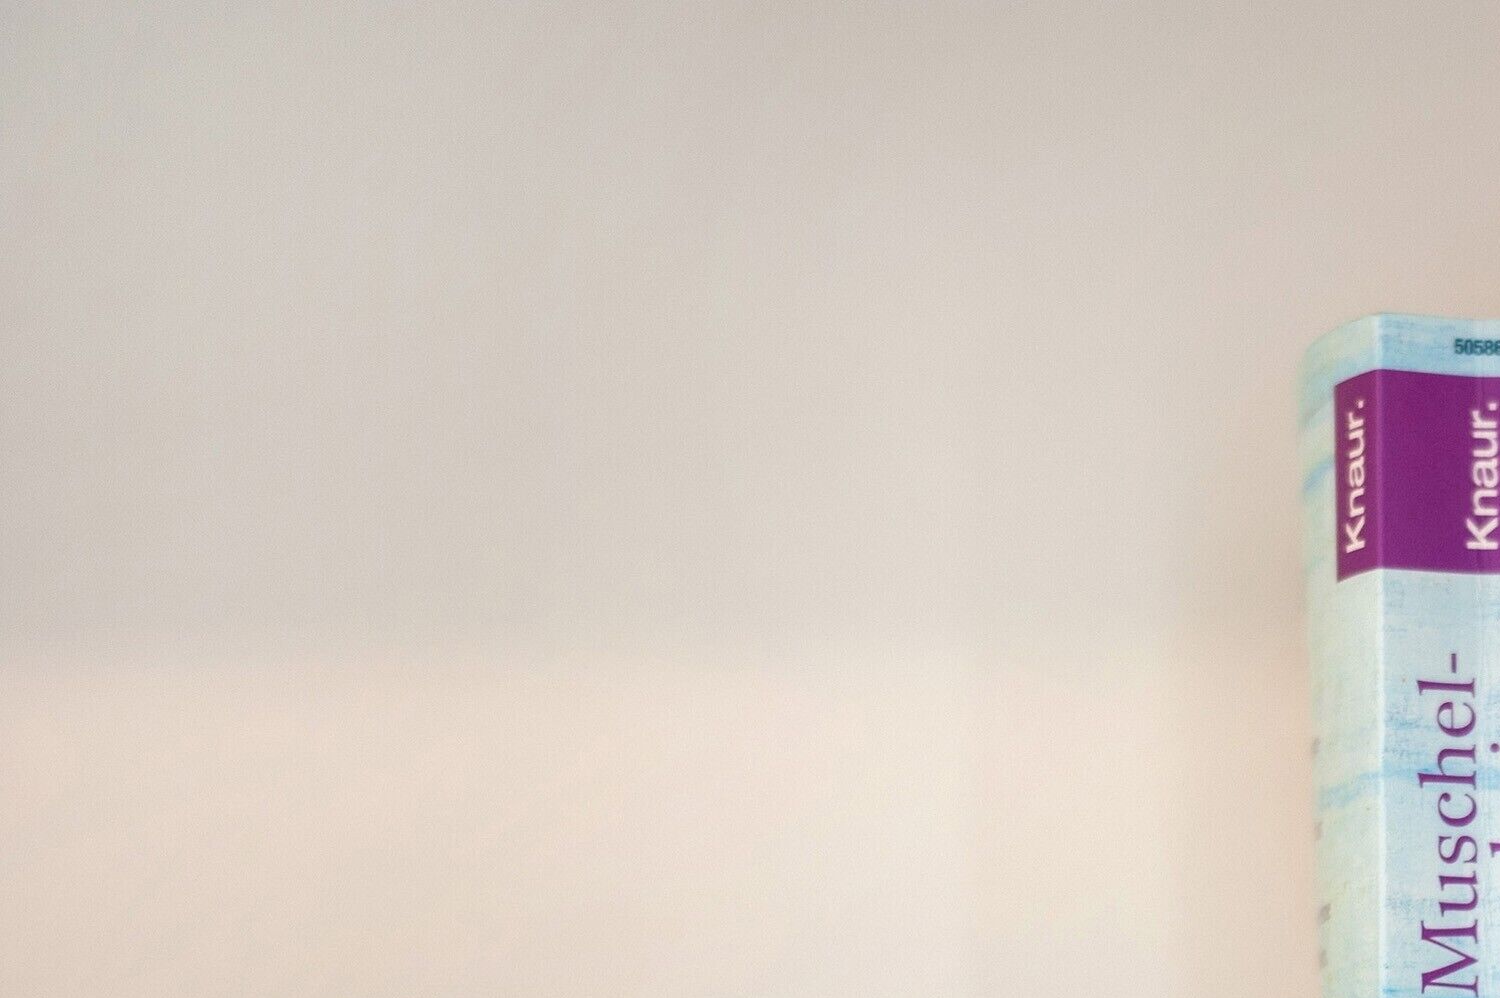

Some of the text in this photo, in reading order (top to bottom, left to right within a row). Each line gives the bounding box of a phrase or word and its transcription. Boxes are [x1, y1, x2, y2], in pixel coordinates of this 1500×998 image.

[1343, 398, 1366, 554] Knaur.
[1466, 399, 1500, 552] Knaur.
[1417, 651, 1480, 998] Muschel-
